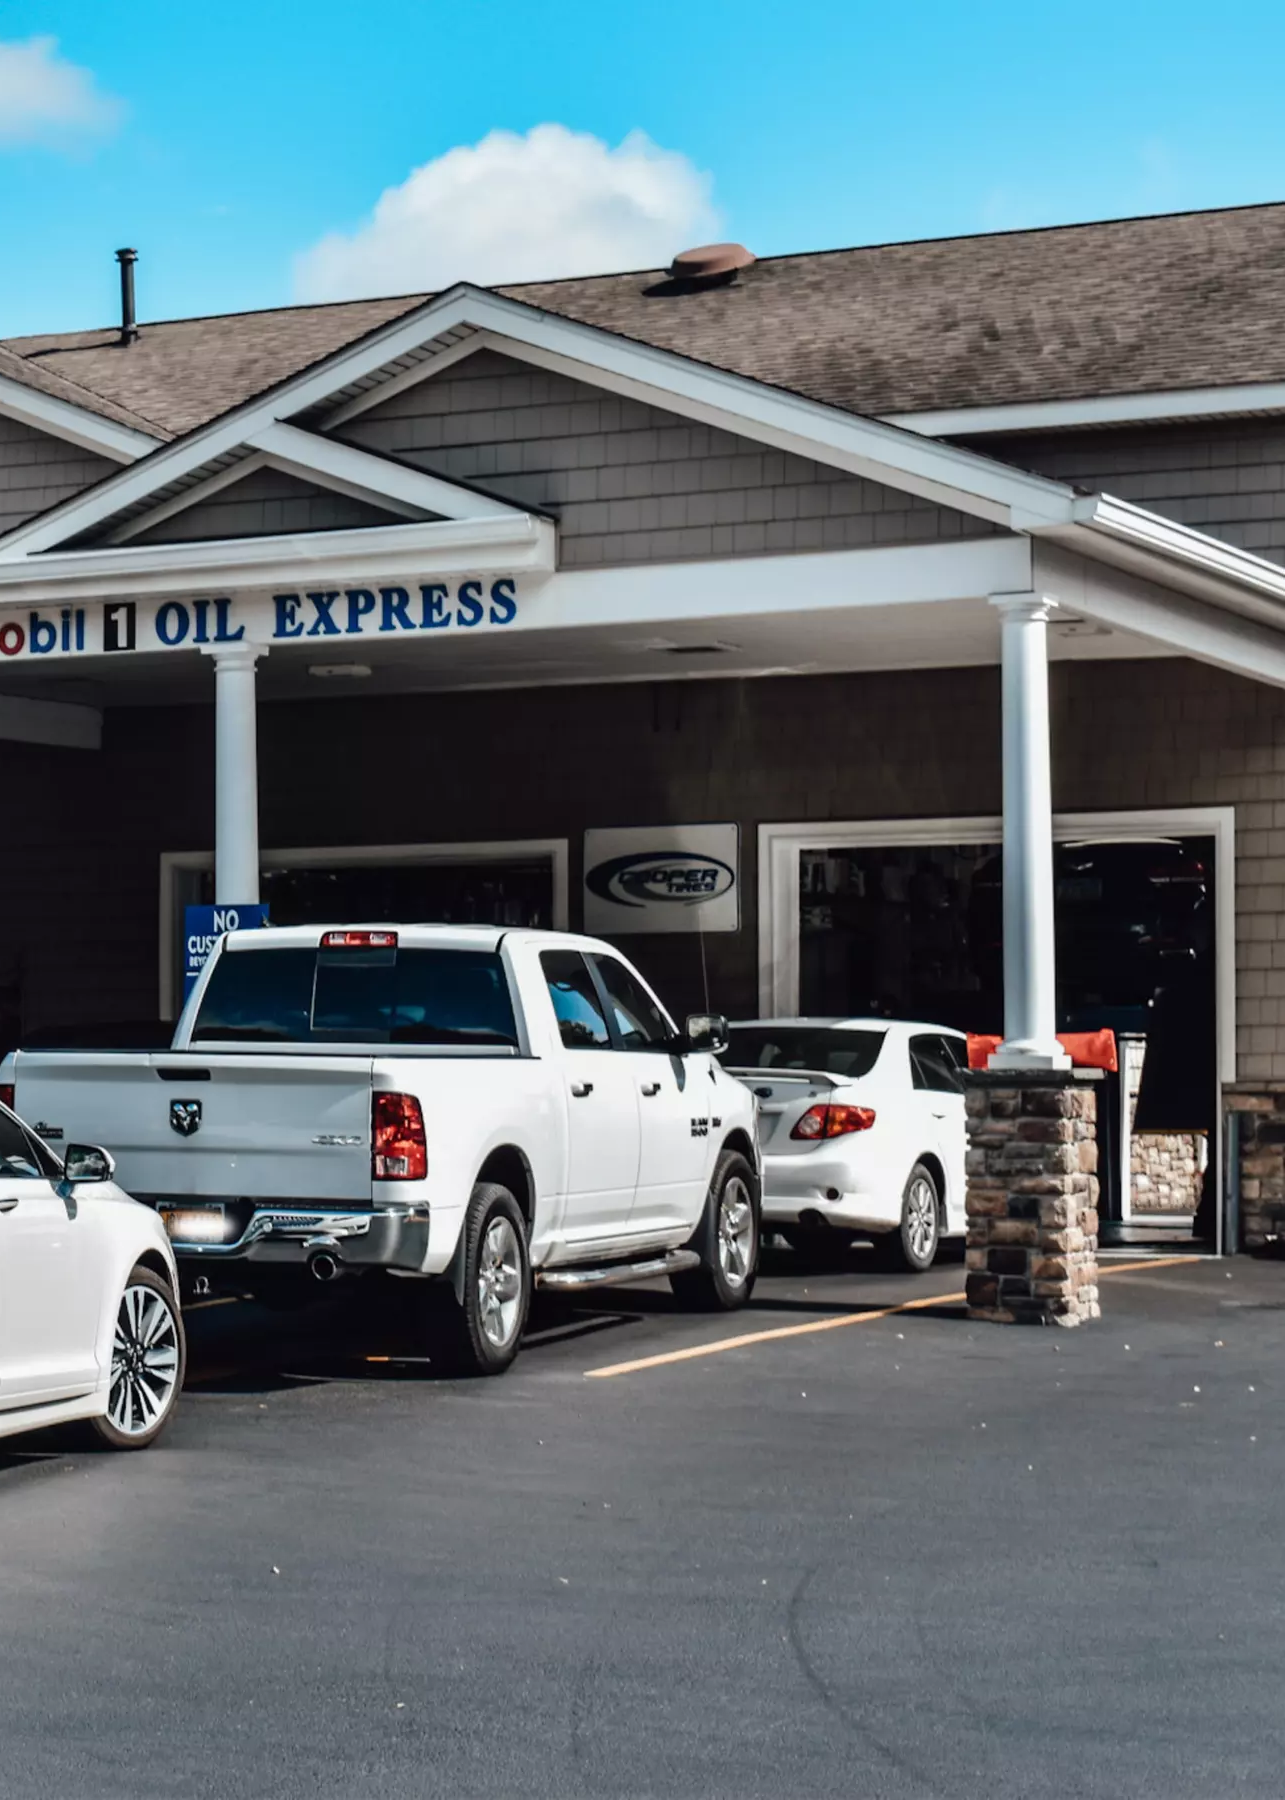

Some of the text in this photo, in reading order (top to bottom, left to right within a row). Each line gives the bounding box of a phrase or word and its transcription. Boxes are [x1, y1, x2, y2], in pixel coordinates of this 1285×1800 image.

[109, 605, 130, 649] 1
[156, 598, 245, 645] OIL
[272, 579, 517, 638] EXPRESS
[618, 868, 719, 884] COOPER
[667, 881, 715, 893] TIRES
[213, 909, 240, 932] NO
